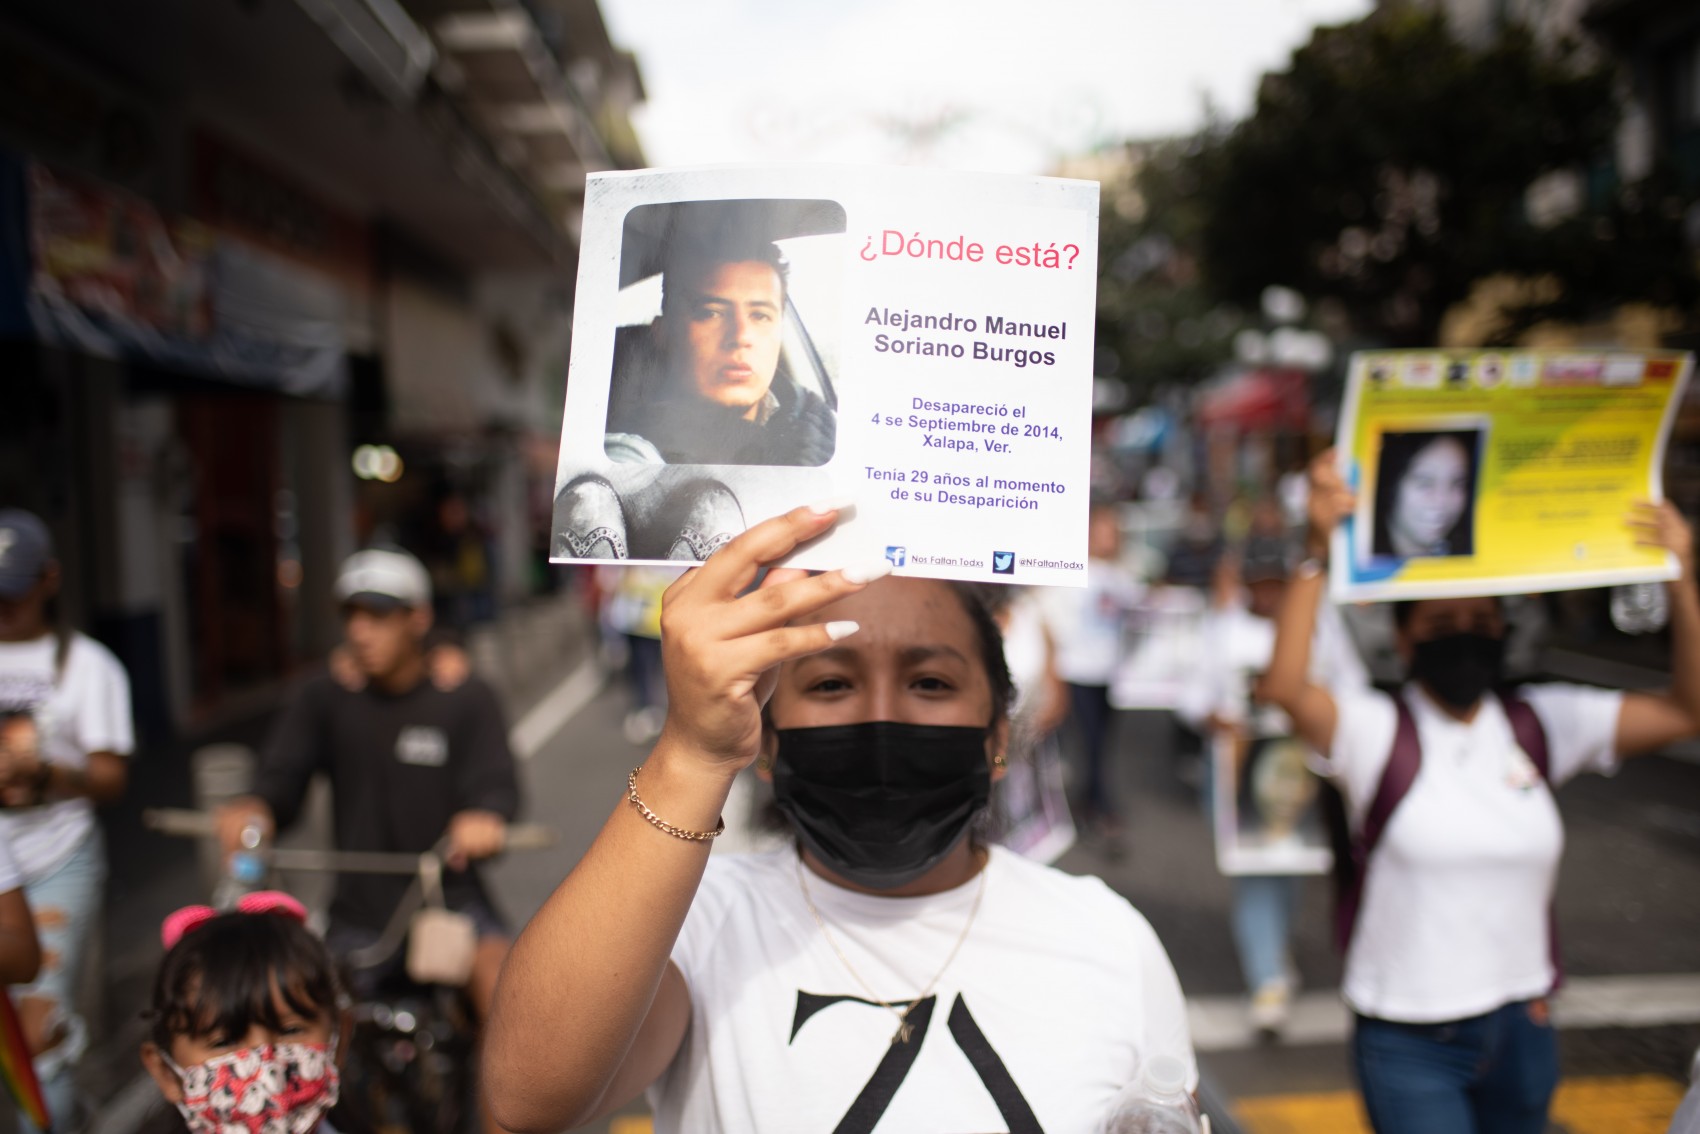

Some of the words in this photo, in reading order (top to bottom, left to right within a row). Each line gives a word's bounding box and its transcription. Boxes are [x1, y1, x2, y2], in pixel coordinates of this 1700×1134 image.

[860, 230, 984, 262] ¿Dónde
[995, 242, 1080, 270] está?
[864, 306, 978, 333] Alejandro
[985, 315, 1067, 340] Manuel
[874, 333, 965, 358] Soriano
[973, 341, 1056, 368] Burgos
[912, 397, 1008, 416] Desapareció
[1012, 406, 1026, 418] el
[871, 412, 880, 425] 4
[885, 416, 903, 426] se
[908, 415, 996, 434] Septiembre
[1000, 420, 1019, 436] de
[1023, 424, 1064, 441] 2014,
[922, 434, 979, 453] Xalapa,
[984, 439, 1012, 454] Ver.
[864, 466, 906, 482] Tenía
[910, 470, 928, 484] 29
[933, 472, 970, 487] años
[975, 475, 989, 488] al
[993, 480, 1066, 494] momento
[890, 487, 909, 501] de
[914, 492, 933, 502] su
[937, 490, 1039, 510] Desaparición
[911, 554, 928, 564] Nos
[960, 558, 984, 568] Todxs
